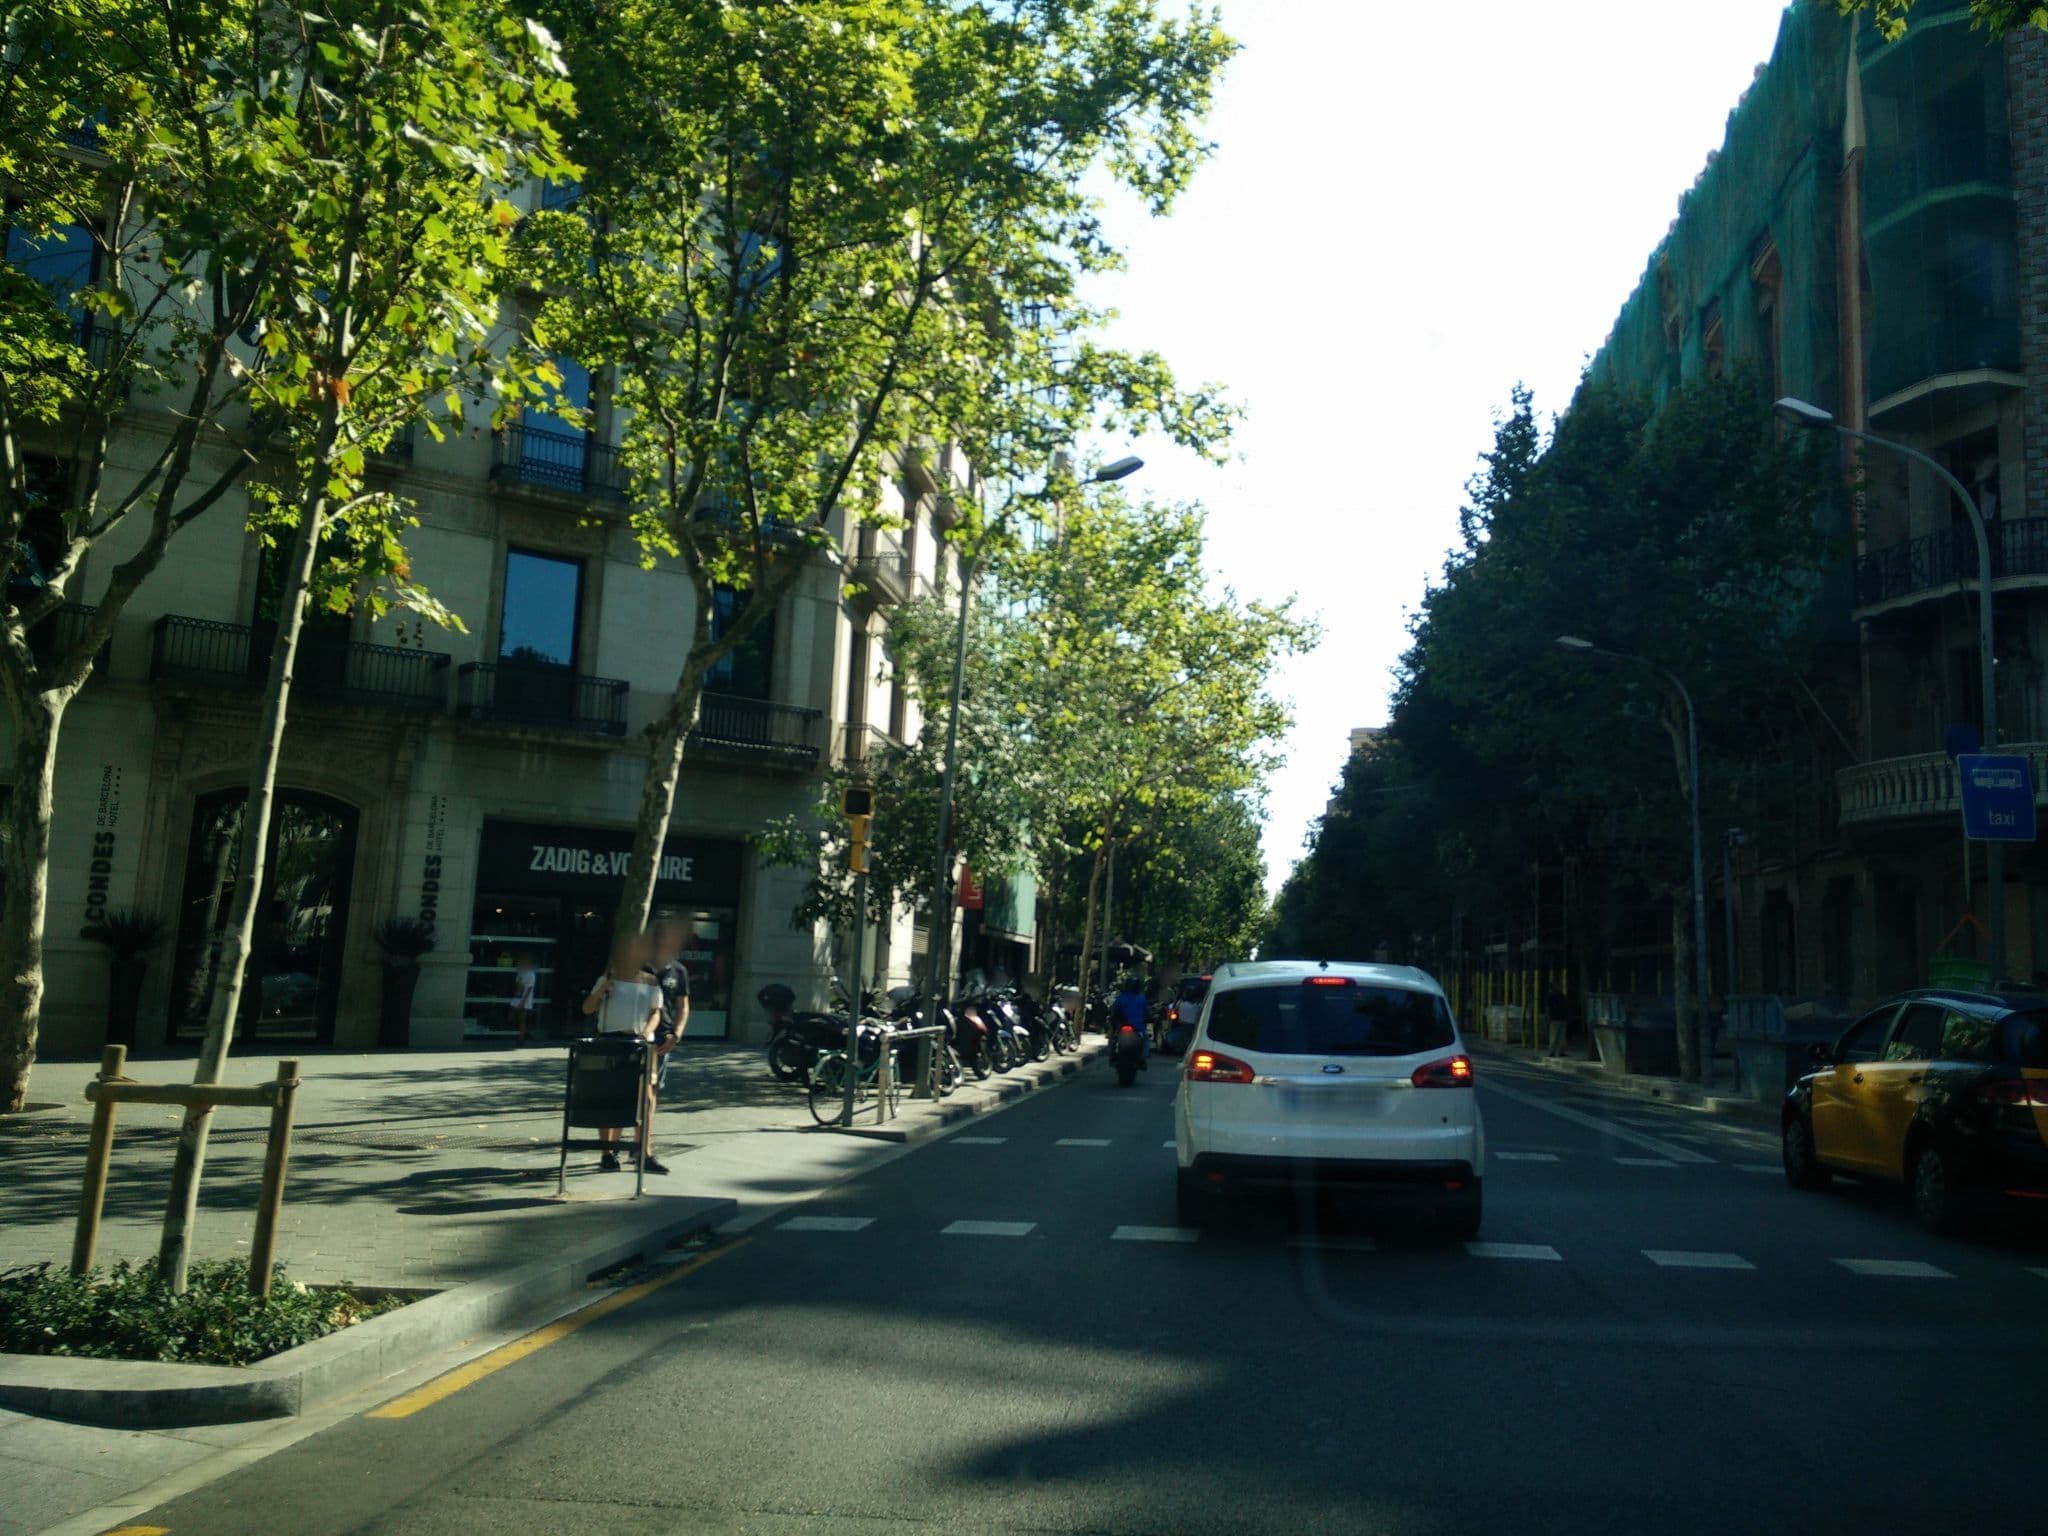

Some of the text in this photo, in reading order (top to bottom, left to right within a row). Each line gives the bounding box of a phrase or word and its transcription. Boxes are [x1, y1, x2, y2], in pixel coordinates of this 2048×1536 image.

[99, 764, 113, 812] BARCELONA
[109, 801, 120, 827] HOTEL
[1988, 809, 2017, 826] taxi
[85, 831, 116, 922] CONDES
